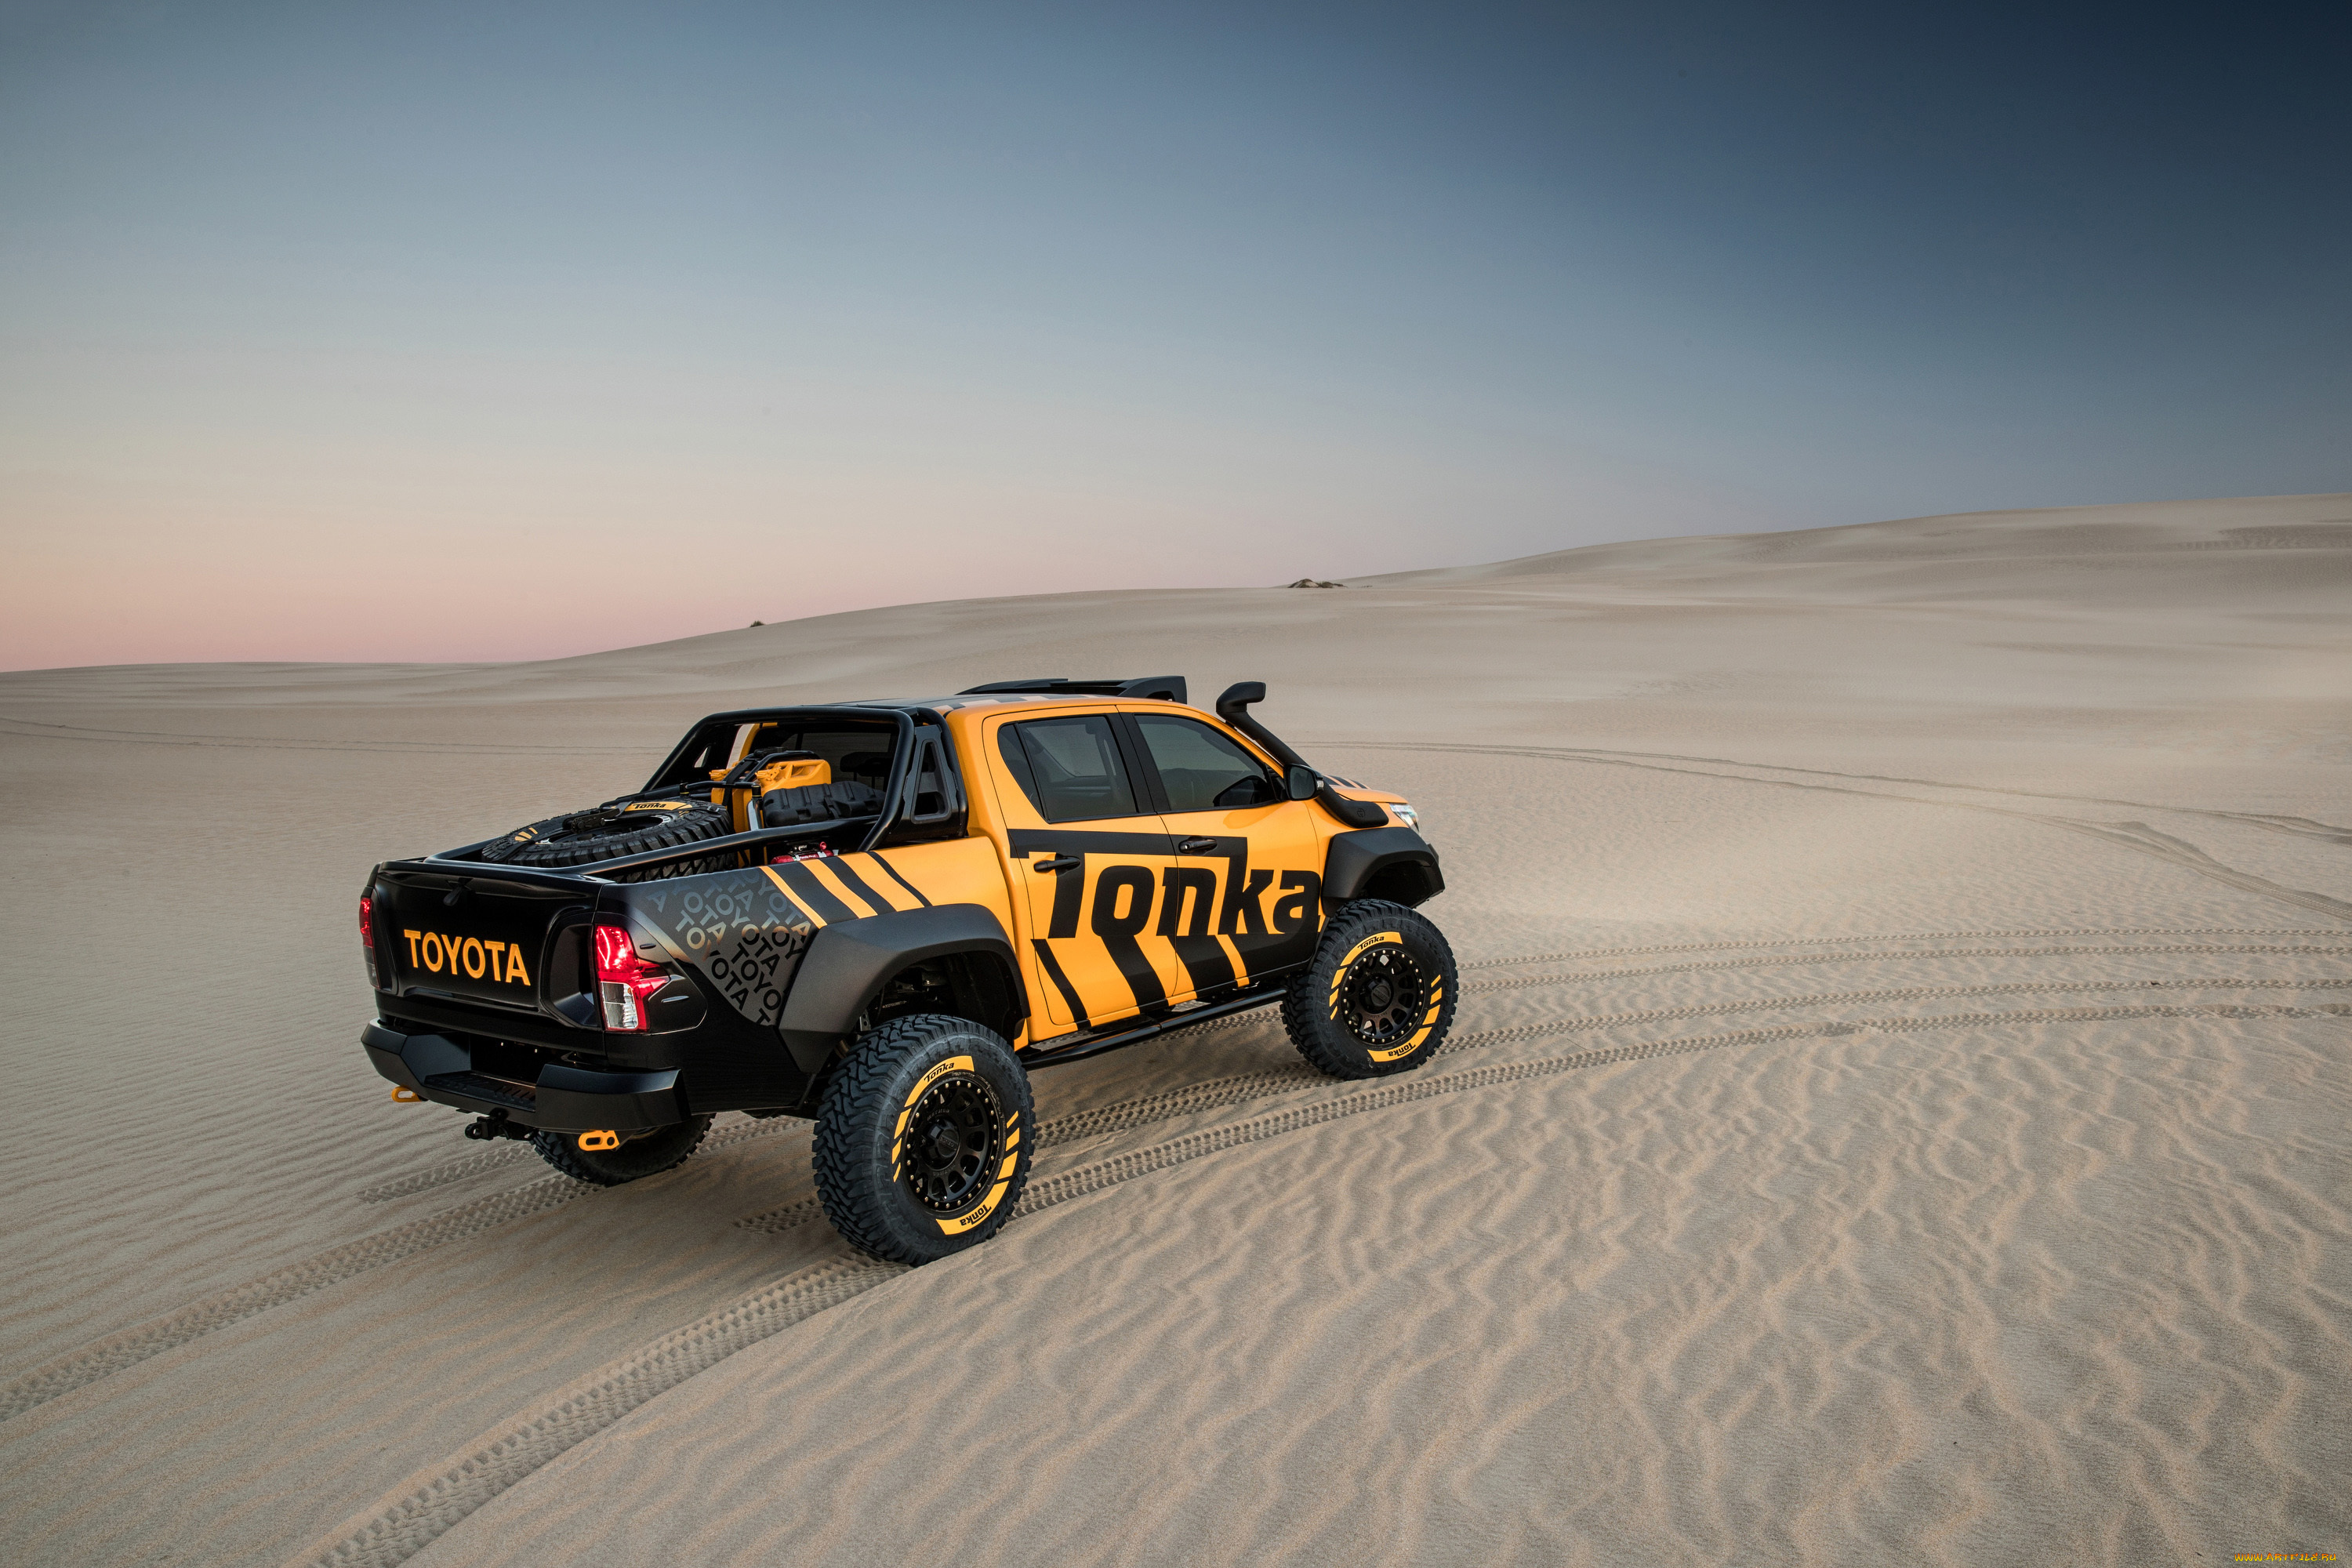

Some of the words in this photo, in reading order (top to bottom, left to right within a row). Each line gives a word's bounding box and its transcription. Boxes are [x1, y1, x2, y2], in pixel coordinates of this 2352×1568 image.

[1007, 829, 1321, 938] Tonka
[704, 878, 780, 977] TOYOTA
[1357, 935, 1385, 950] Tonka
[404, 929, 531, 986] TOYOTA
[676, 909, 750, 1011] TOYOTA
[1388, 1042, 1416, 1057] Tonka
[924, 1062, 955, 1083] Tonka
[959, 1204, 992, 1226] Tonka
